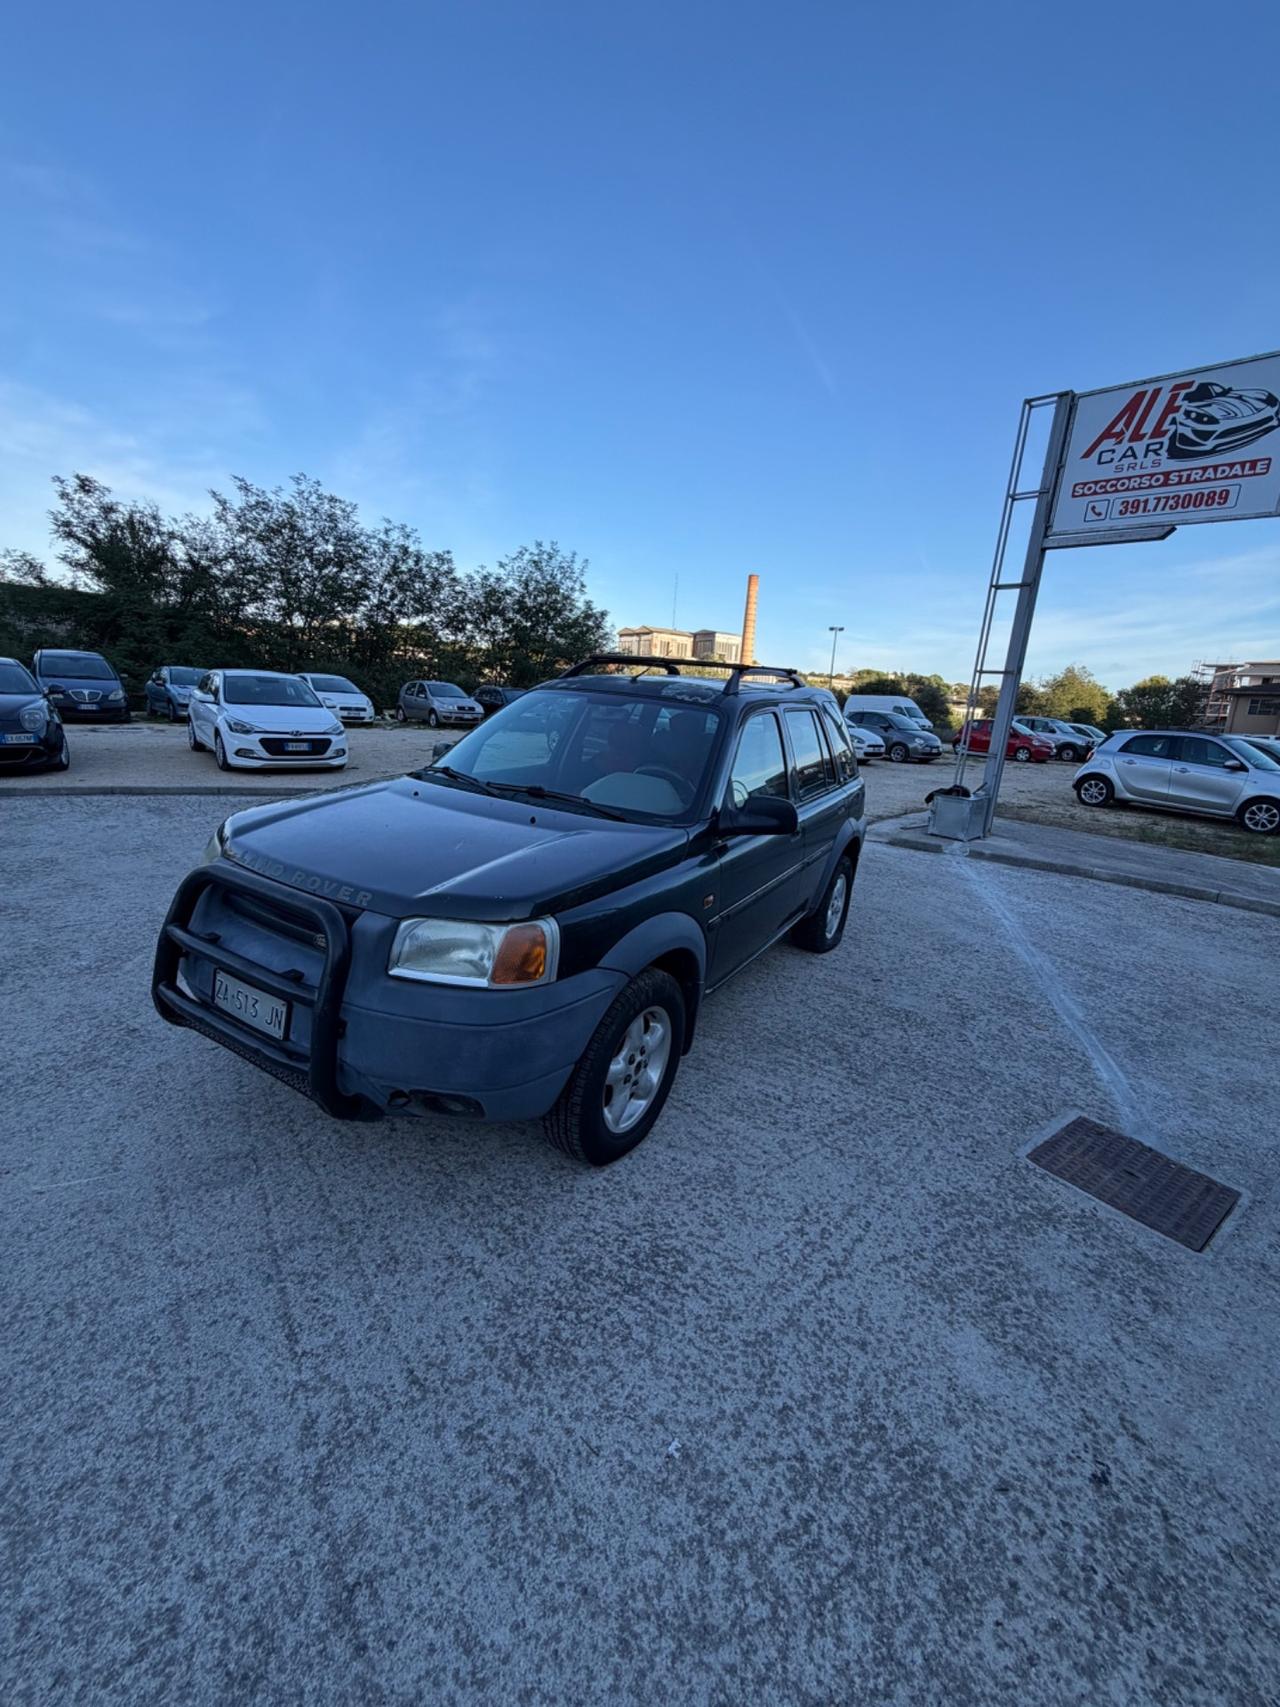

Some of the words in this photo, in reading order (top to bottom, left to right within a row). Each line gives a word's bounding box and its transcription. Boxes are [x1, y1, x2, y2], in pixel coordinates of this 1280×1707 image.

[1080, 379, 1196, 459] ALE
[1097, 441, 1164, 465] CAR
[1113, 458, 1162, 473] SRLS
[1074, 473, 1164, 496] SOCCORSO
[1168, 459, 1269, 484] STRADALE
[1118, 488, 1231, 516] 391.7730089
[291, 871, 373, 906] ROVER
